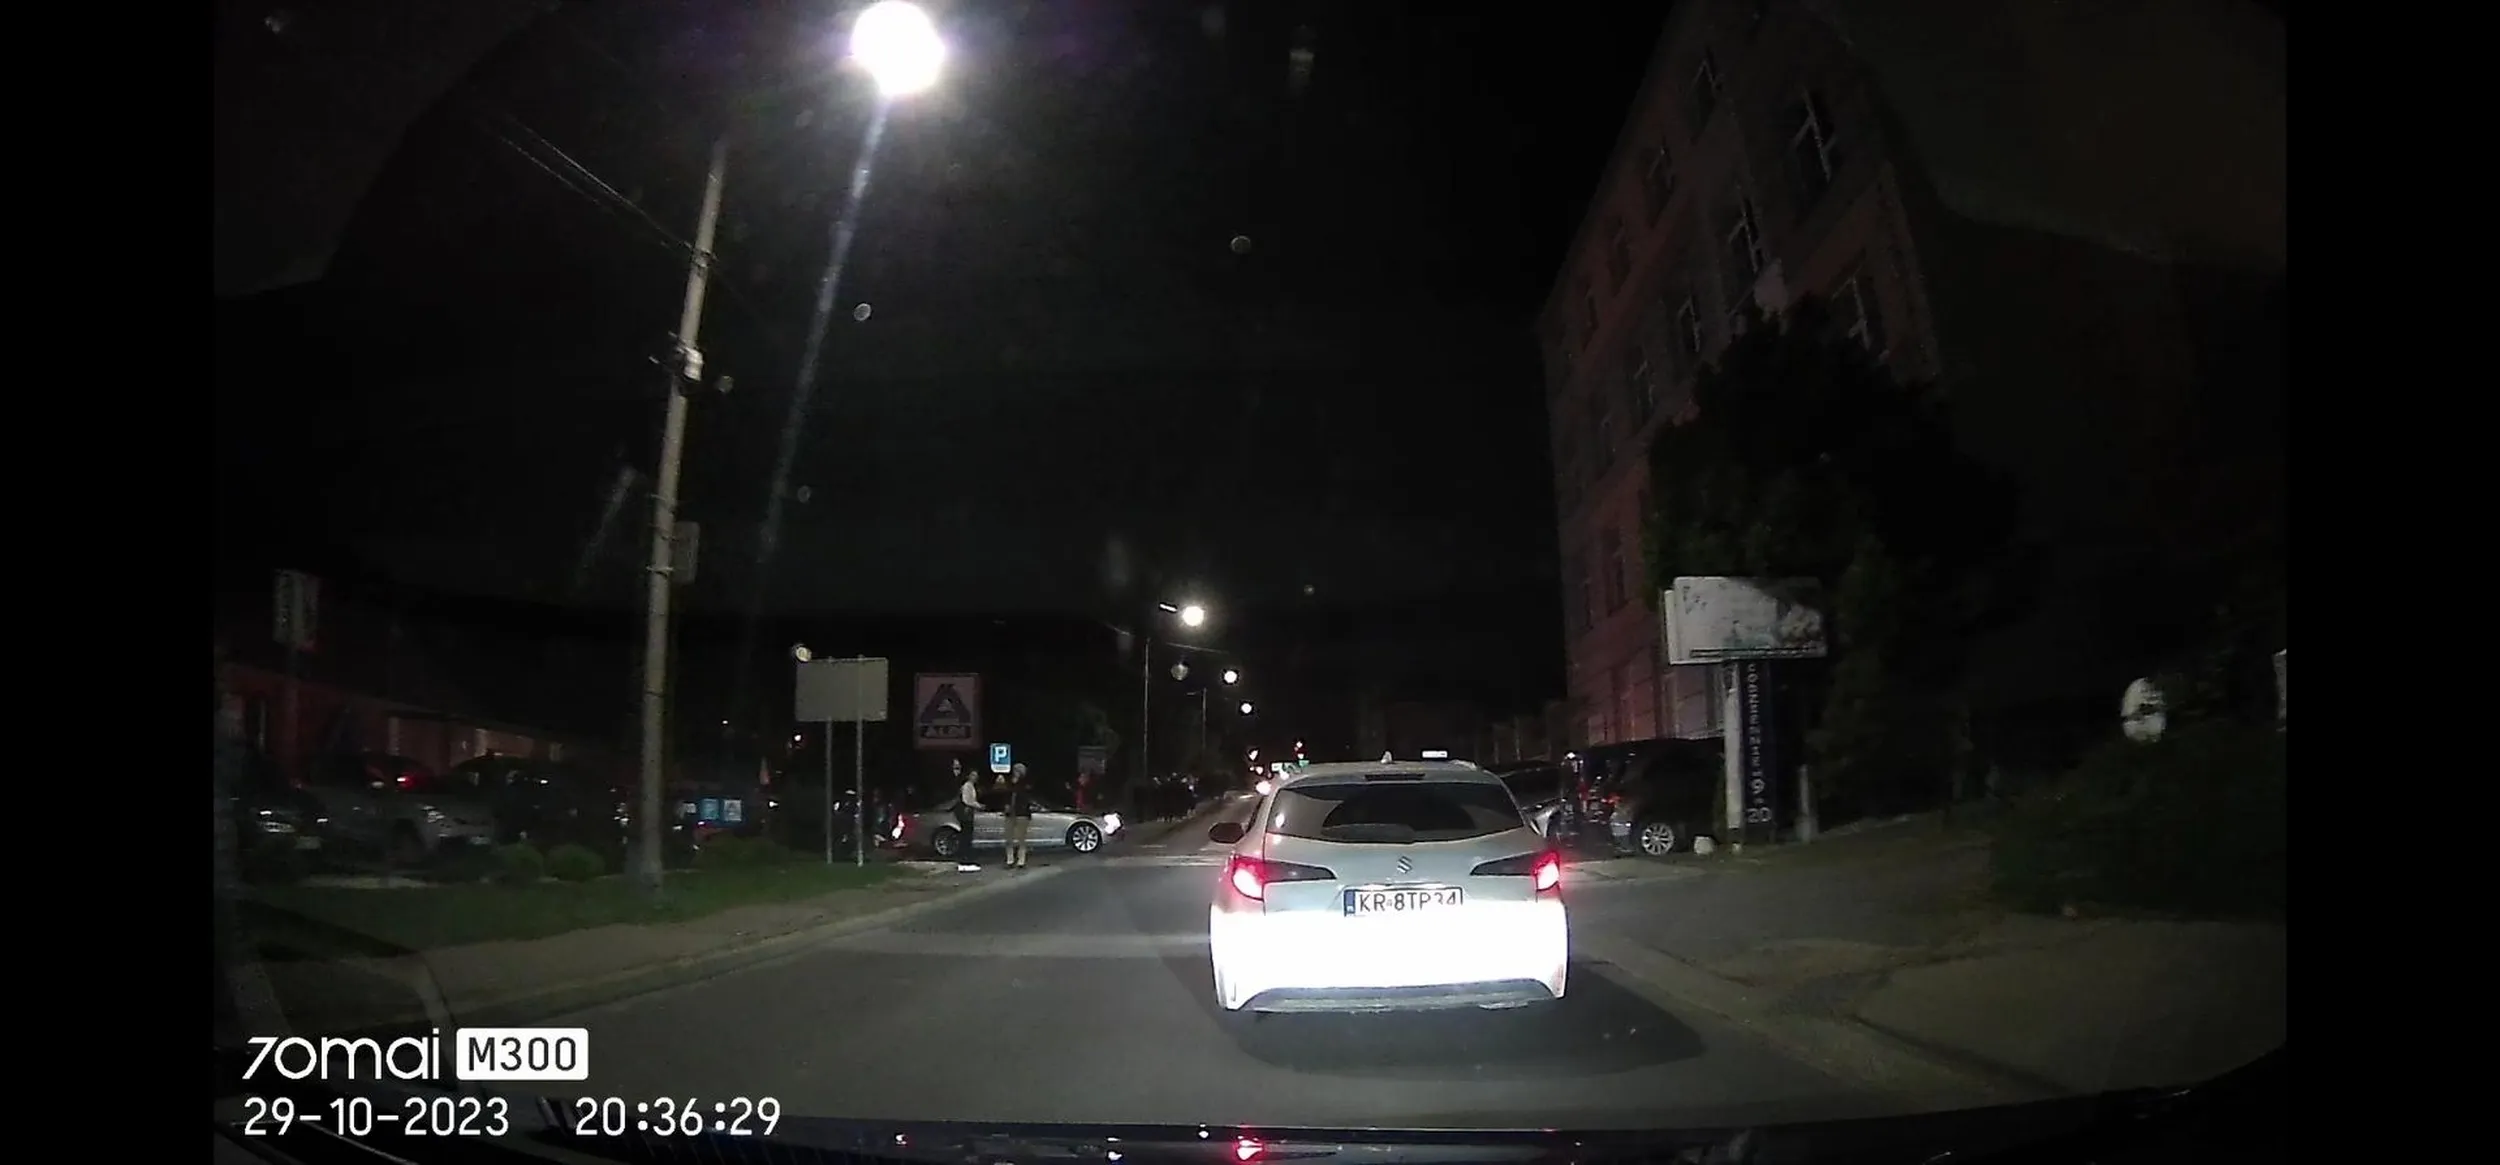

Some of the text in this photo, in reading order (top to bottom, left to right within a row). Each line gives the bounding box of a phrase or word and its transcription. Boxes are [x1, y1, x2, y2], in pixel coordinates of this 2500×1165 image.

[994, 745, 1008, 762] P
[1750, 778, 1766, 795] 9
[1747, 807, 1772, 824] 20
[1360, 892, 1385, 911] KR
